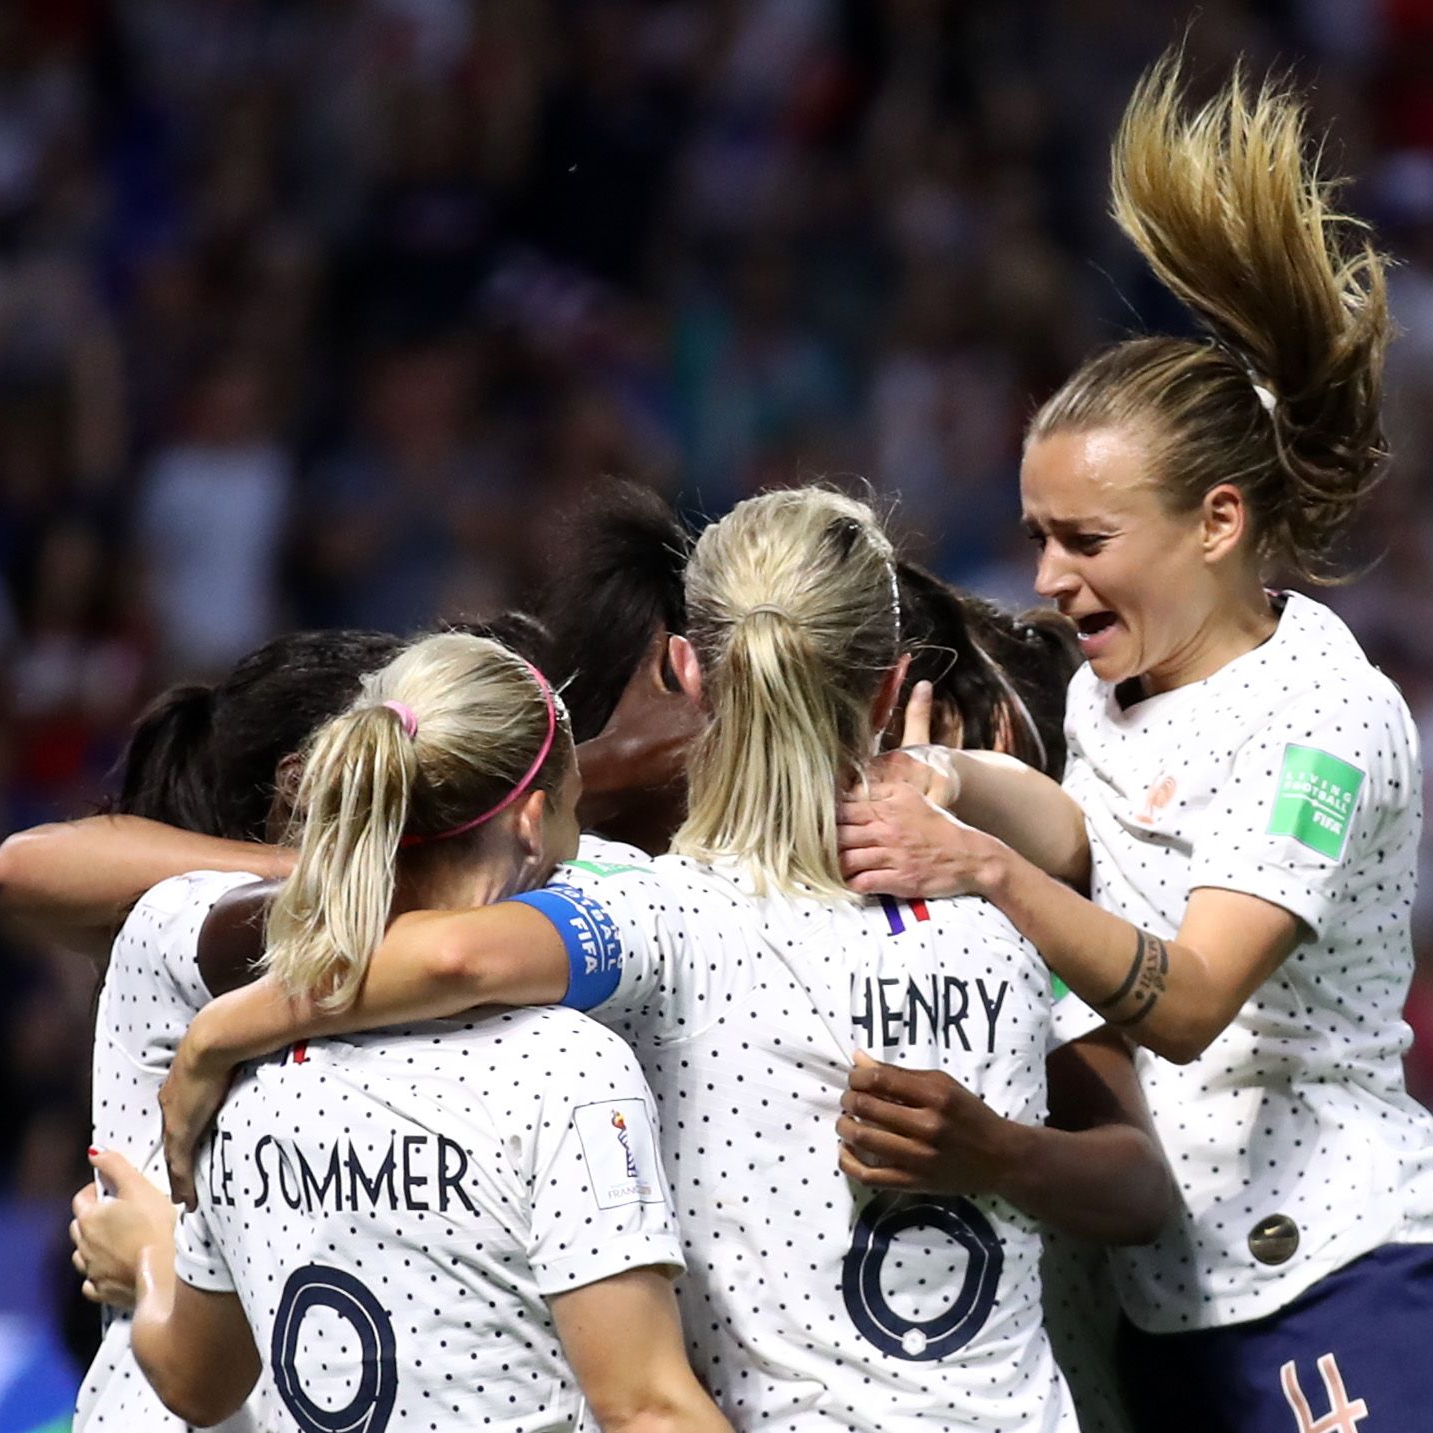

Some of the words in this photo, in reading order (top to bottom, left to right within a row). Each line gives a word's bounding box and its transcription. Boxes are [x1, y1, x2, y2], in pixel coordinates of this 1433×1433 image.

[1283, 779, 1347, 814] FOOTBALL
[1285, 770, 1352, 804] LIVING
[1313, 811, 1343, 835] FIFA
[549, 887, 616, 971] OOTBALL
[569, 917, 598, 975] FIFA
[850, 973, 1009, 1054] HENRY
[209, 1131, 235, 1207] LE
[253, 1134, 478, 1212] SOMMER
